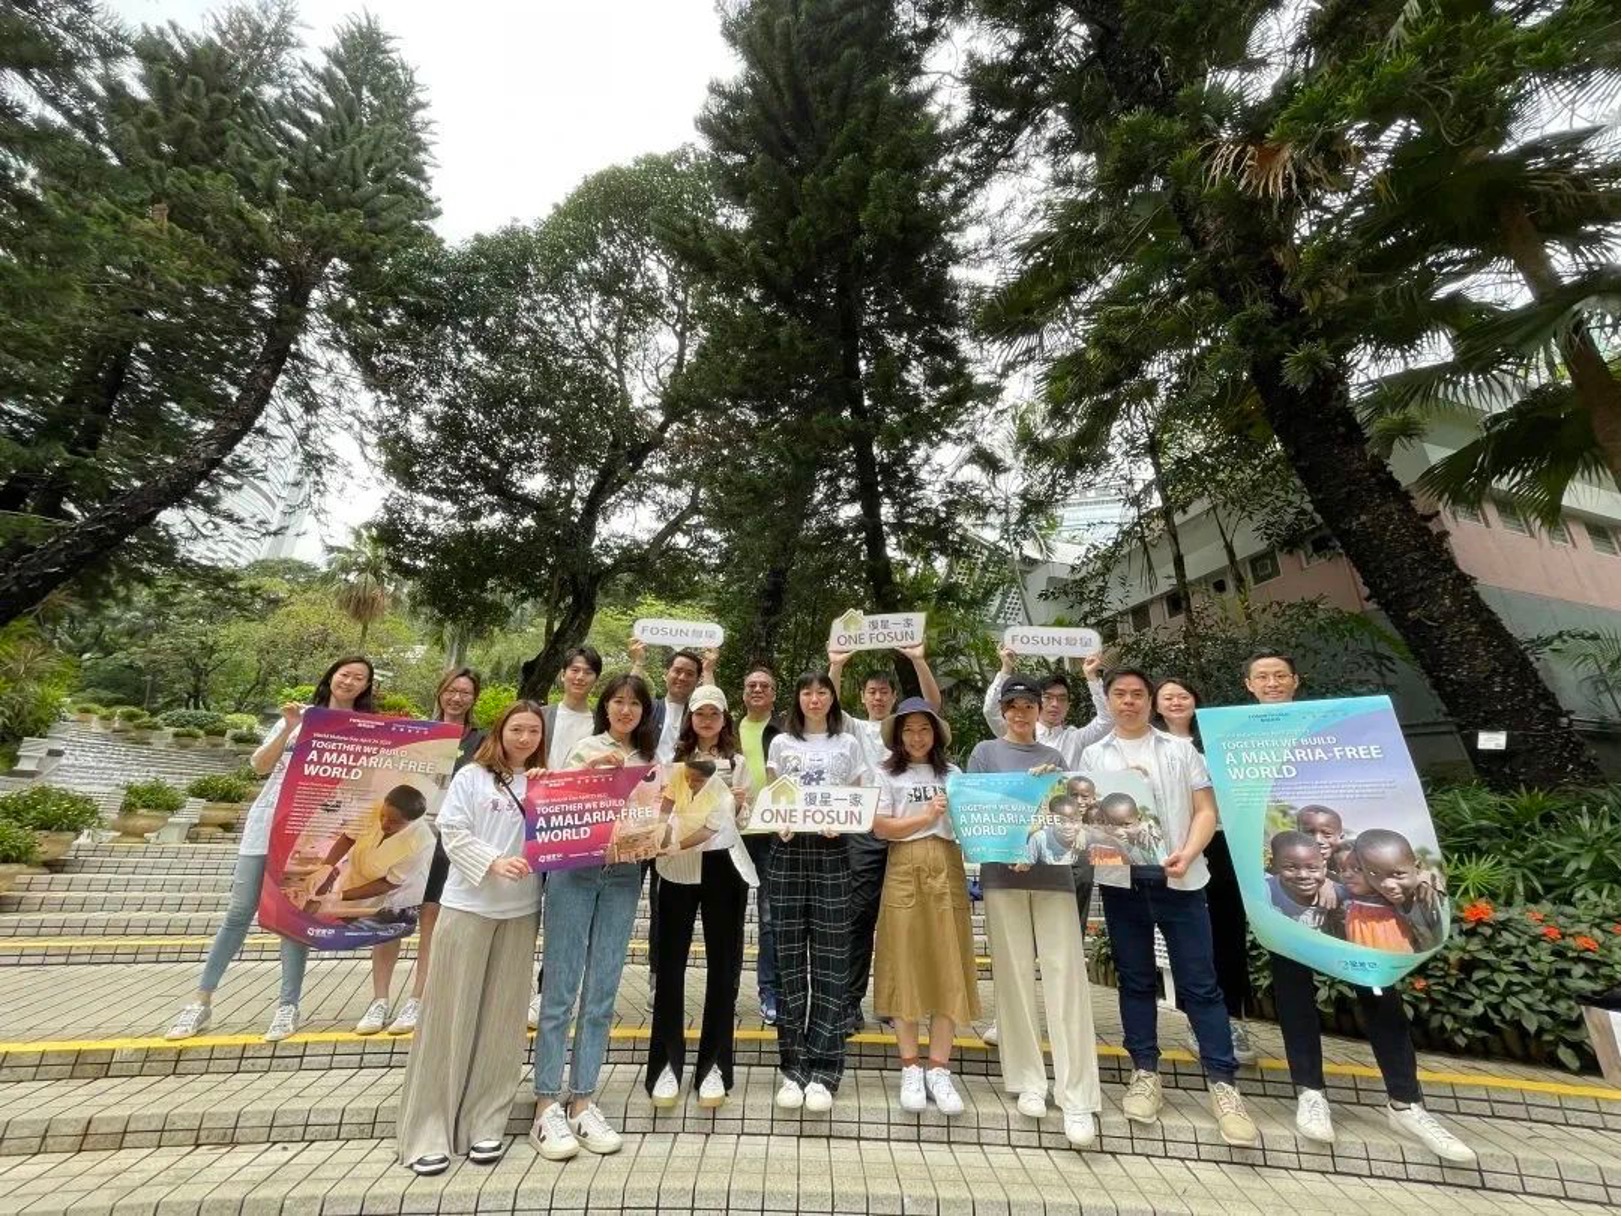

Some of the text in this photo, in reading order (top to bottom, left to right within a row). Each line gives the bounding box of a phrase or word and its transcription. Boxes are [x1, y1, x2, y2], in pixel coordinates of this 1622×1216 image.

[641, 625, 689, 637] FOSUN
[837, 630, 915, 646] ONE FOSUN
[1011, 634, 1062, 646] FOSUN
[311, 739, 408, 757] TOGETHER WE BUILD
[1221, 735, 1337, 750] TOGETHER WE BUILD
[306, 750, 436, 774] A MALARIA-FREE
[1225, 745, 1384, 765] A MALARIA-FREE
[303, 764, 363, 779] WORLD
[1227, 765, 1297, 780] WORLD
[536, 802, 584, 815] TOGETHER
[584, 801, 599, 810] WE
[599, 798, 625, 808] BUILD
[804, 792, 864, 807] 復星一家
[535, 806, 653, 830] A MALARIA-FREE
[760, 808, 862, 825] ONE FOSUN
[960, 813, 1062, 825] A MALARIA-FREE
[535, 827, 591, 844] WORLD
[960, 826, 1007, 837] WORLD
